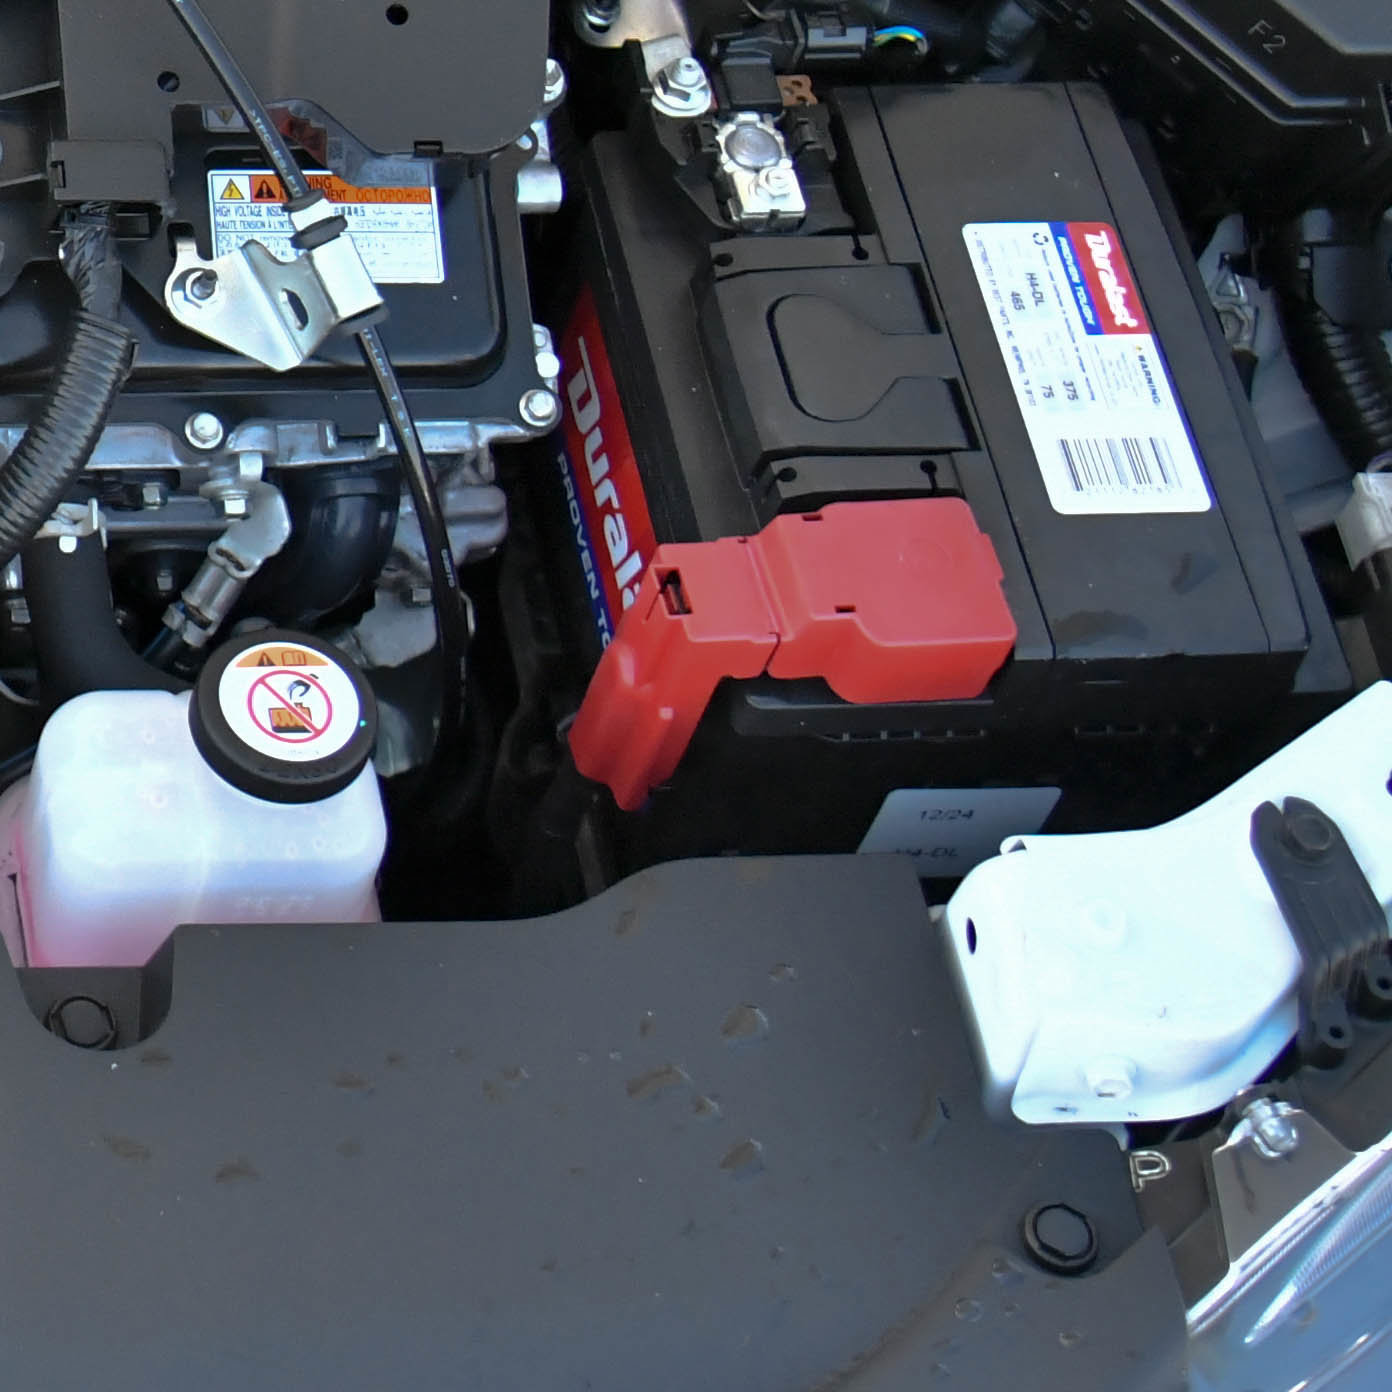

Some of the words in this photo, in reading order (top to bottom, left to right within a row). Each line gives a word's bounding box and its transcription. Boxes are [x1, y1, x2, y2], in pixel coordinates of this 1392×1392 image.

[1084, 229, 1139, 329] Duralast
[1041, 384, 1055, 399] 75
[1062, 379, 1079, 402] 375
[1136, 353, 1161, 407] WARNING
[567, 335, 642, 611] Dural
[557, 452, 601, 600] PROVEN
[919, 808, 975, 821] 12/24
[1129, 1150, 1170, 1193] P
